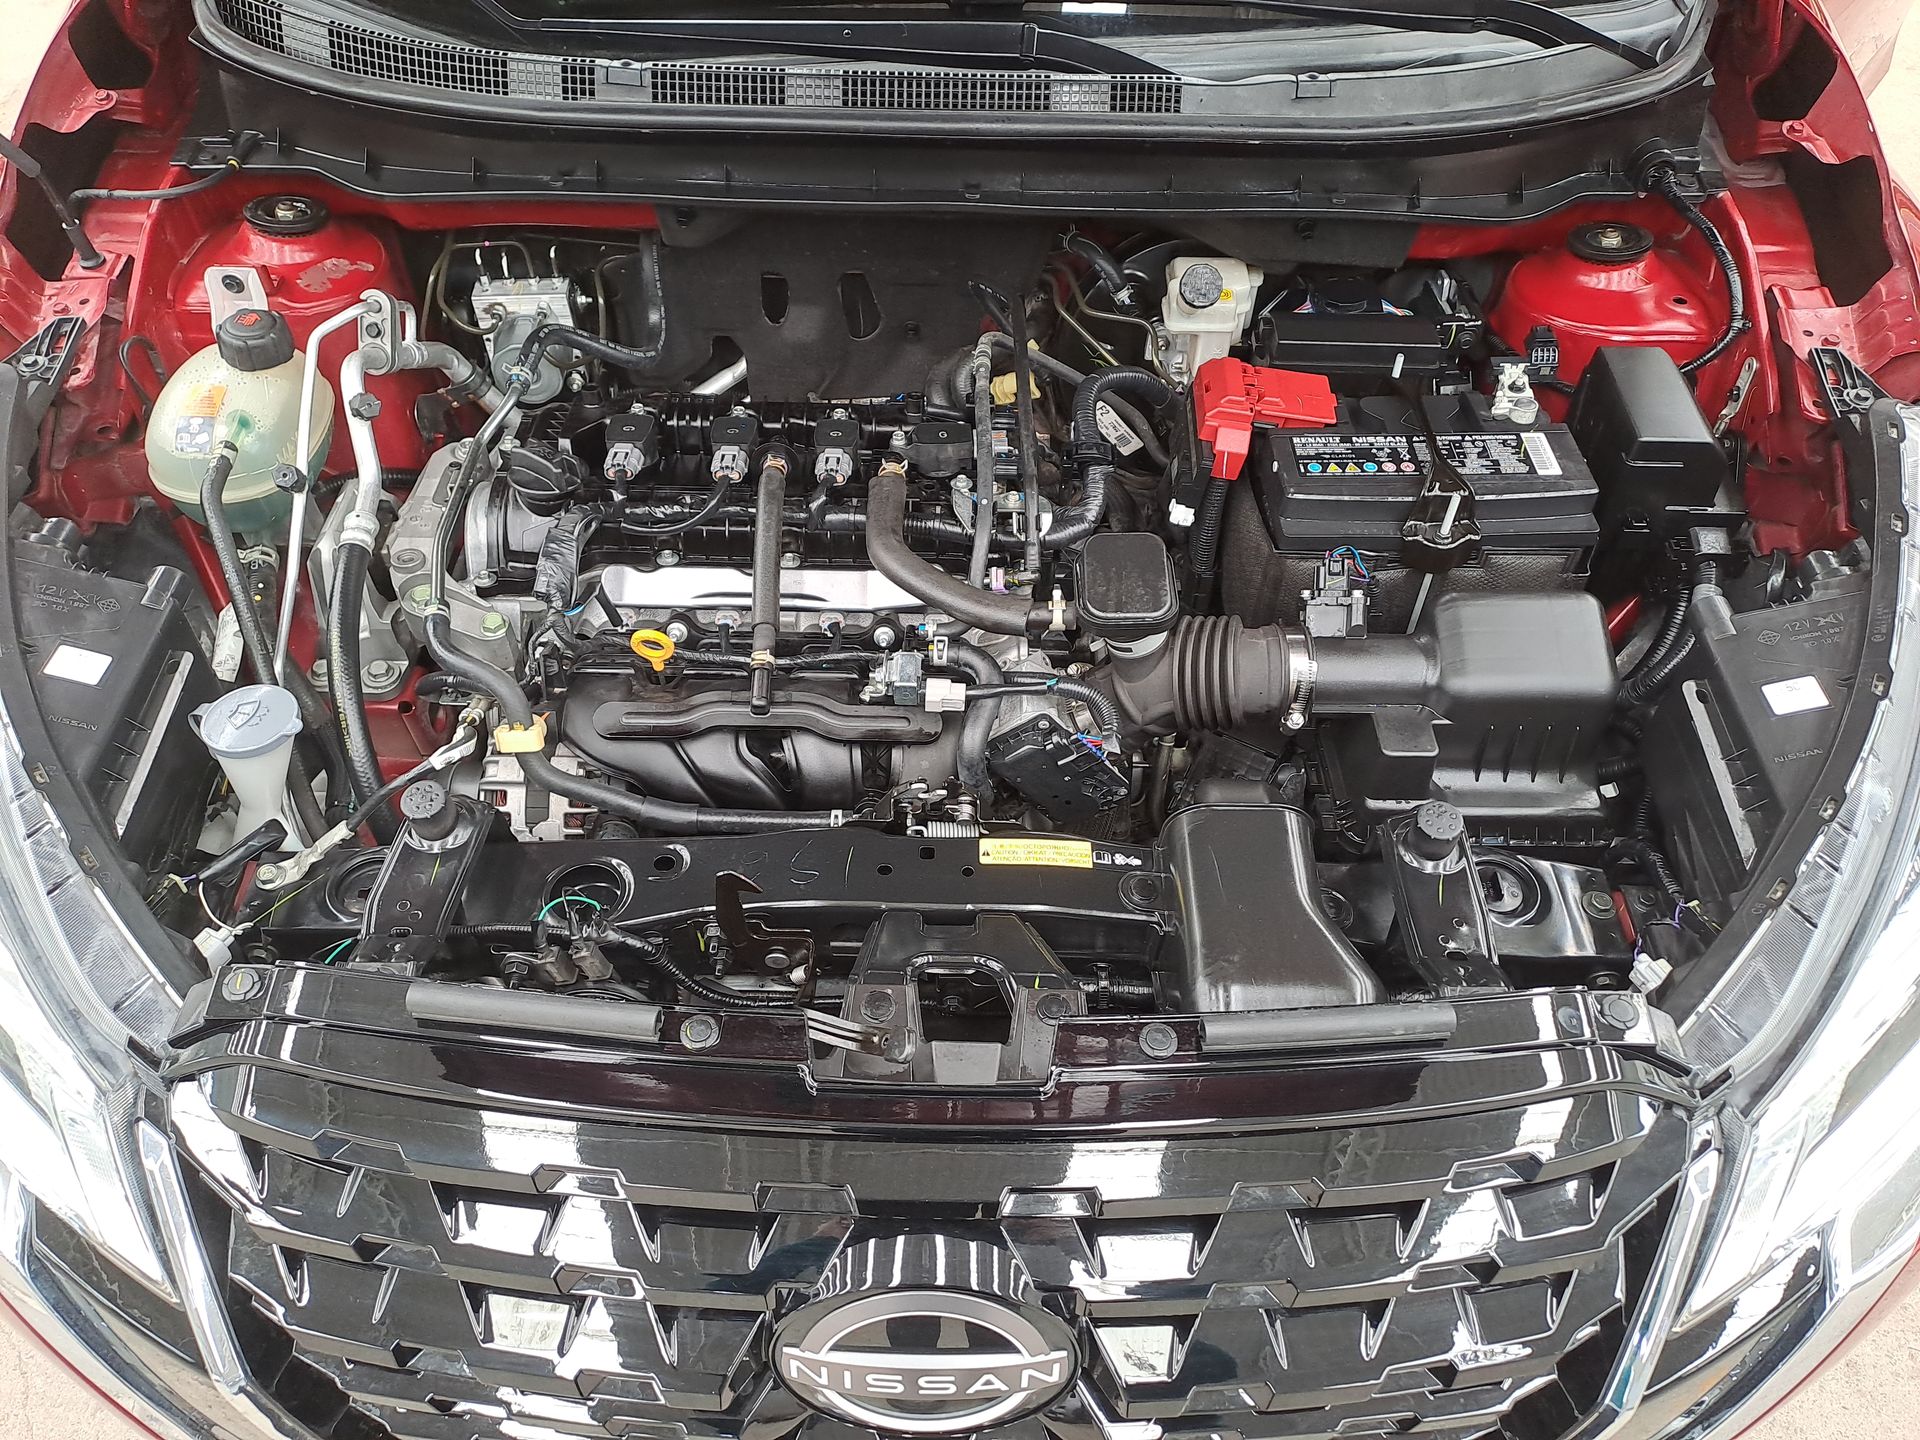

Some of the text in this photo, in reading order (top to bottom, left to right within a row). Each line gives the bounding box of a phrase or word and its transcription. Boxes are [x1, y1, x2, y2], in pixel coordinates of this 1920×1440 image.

[1097, 405, 1110, 417] F2
[938, 431, 948, 439] G
[1783, 618, 1810, 632] 12V
[49, 714, 98, 731] NISSAN
[1774, 748, 1824, 763] NISSAN
[789, 1359, 1061, 1394] NISSAN
